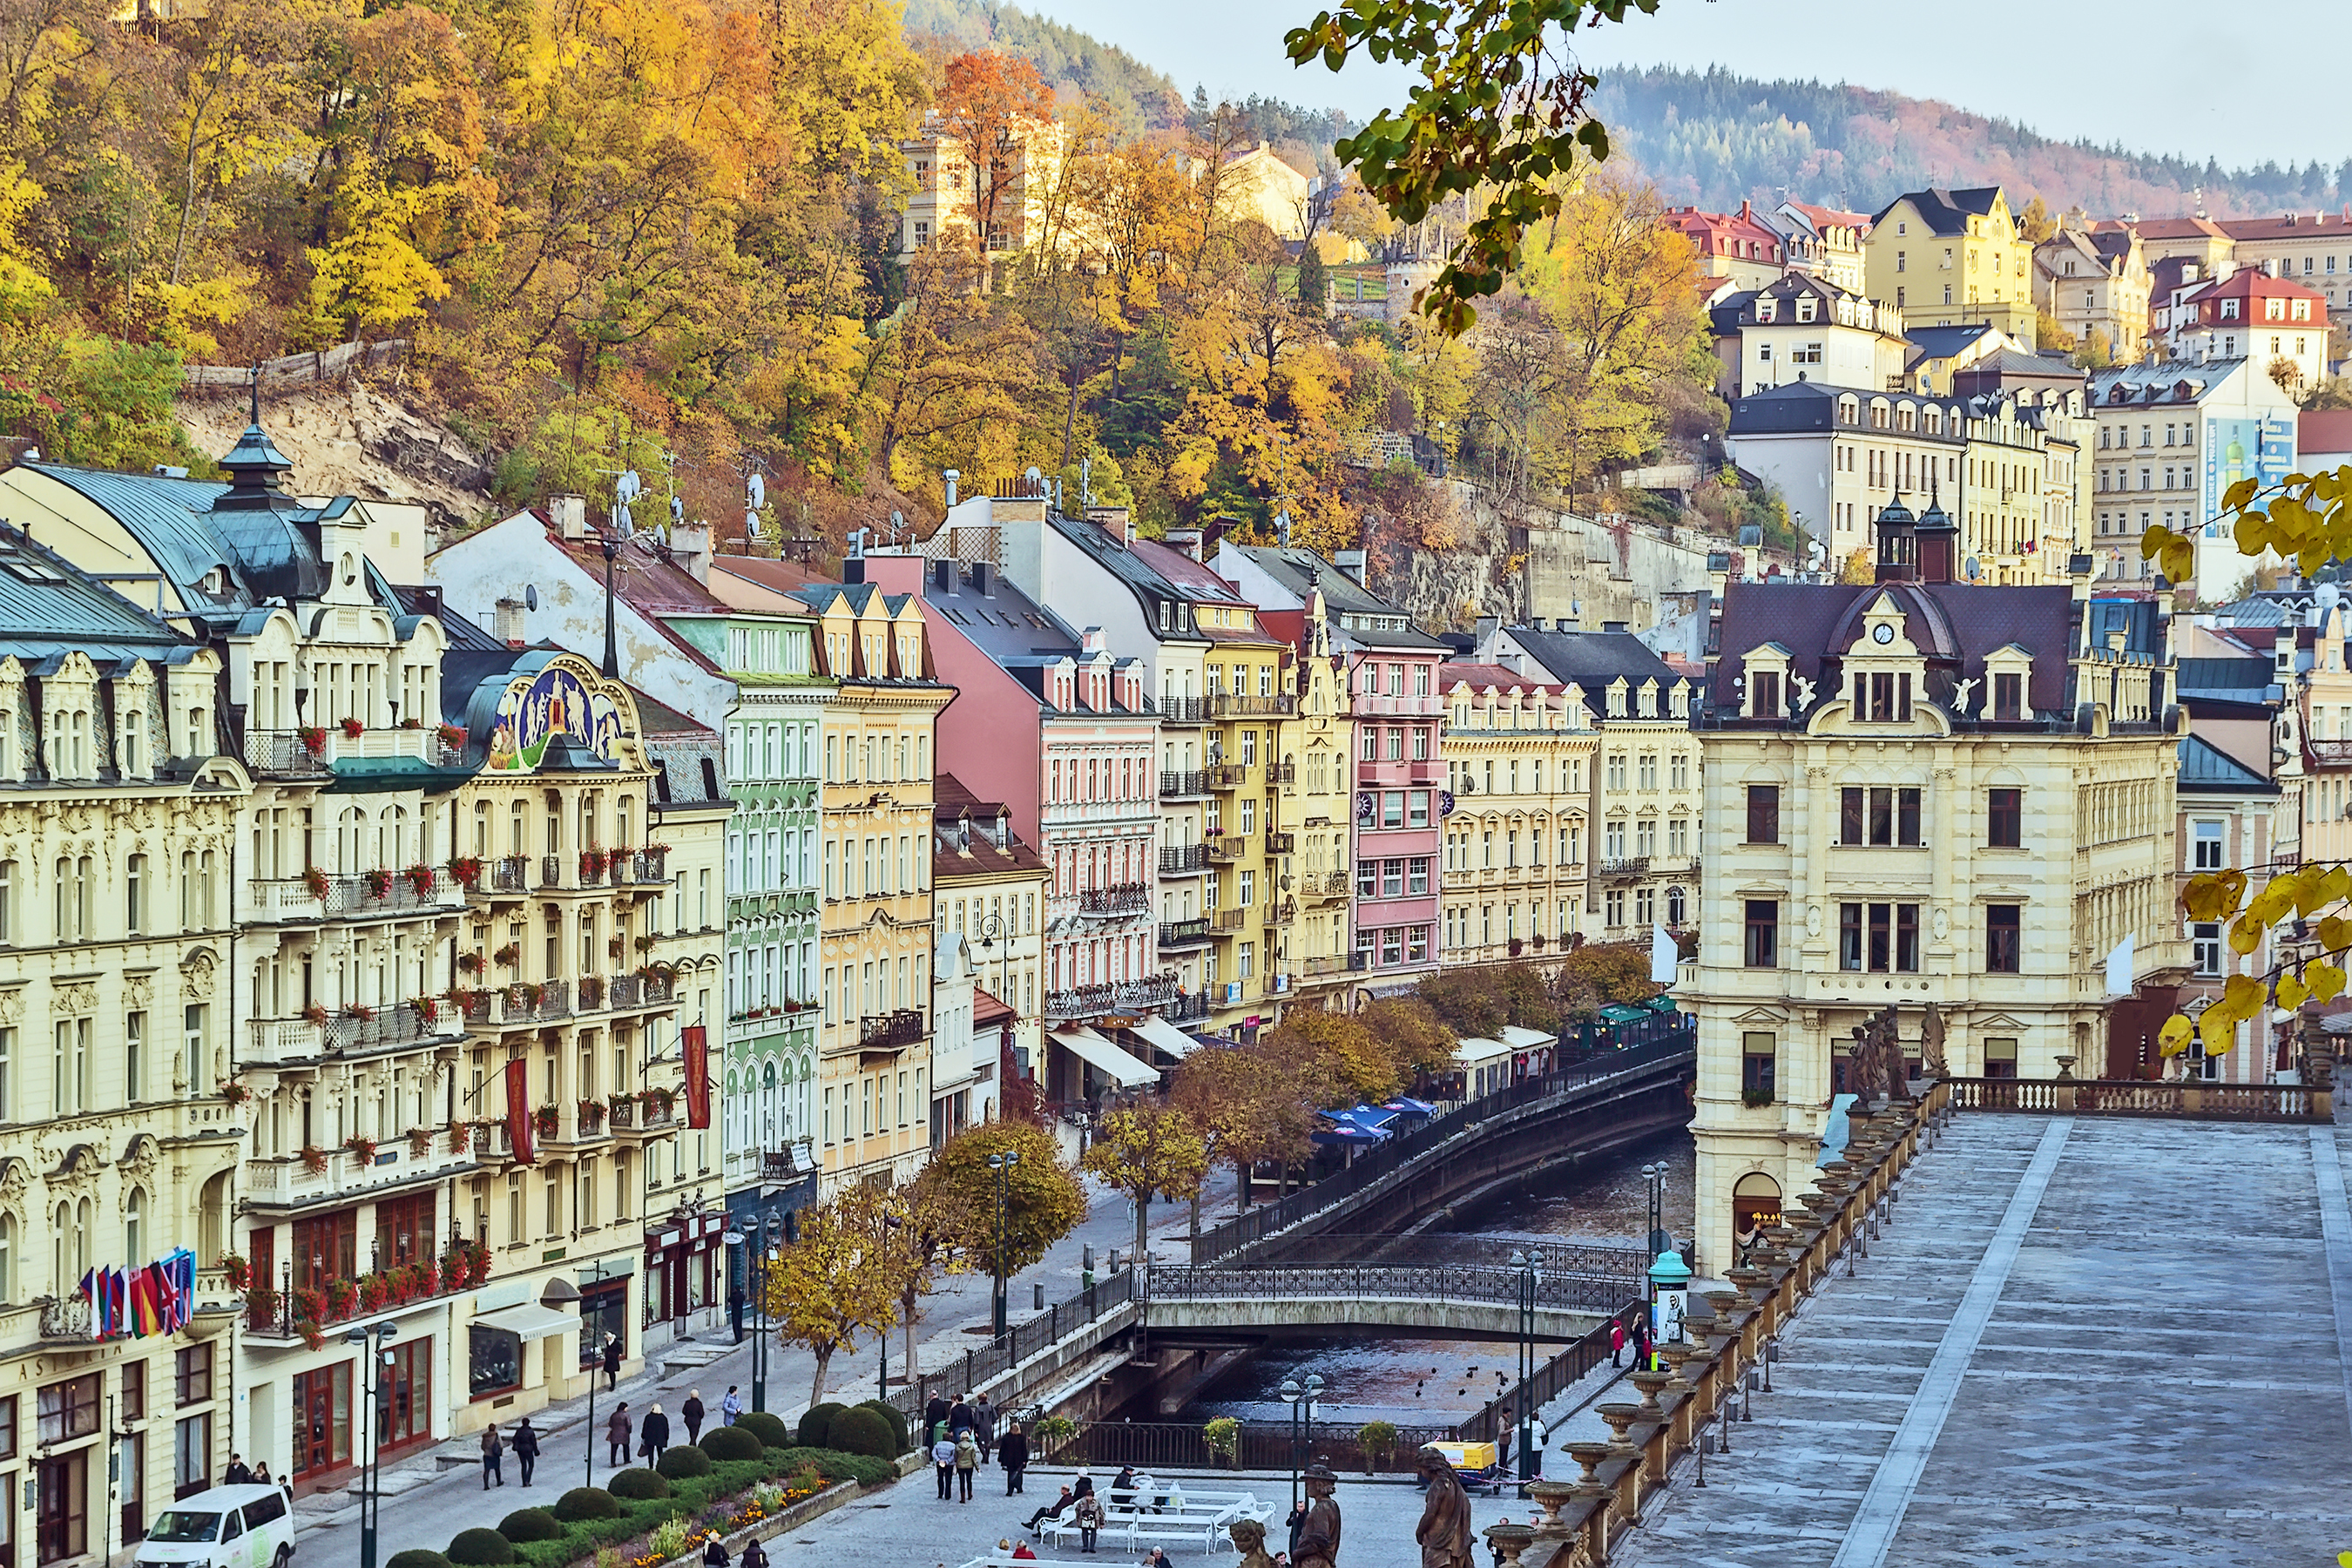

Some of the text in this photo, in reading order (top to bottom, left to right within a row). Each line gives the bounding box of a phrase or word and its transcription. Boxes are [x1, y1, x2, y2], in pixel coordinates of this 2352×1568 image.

[2207, 424, 2216, 462] MUZEUM
[2207, 475, 2215, 511] BECHER
[691, 1039, 705, 1119] ASTORIA
[512, 1073, 528, 1159] ASTORIA
